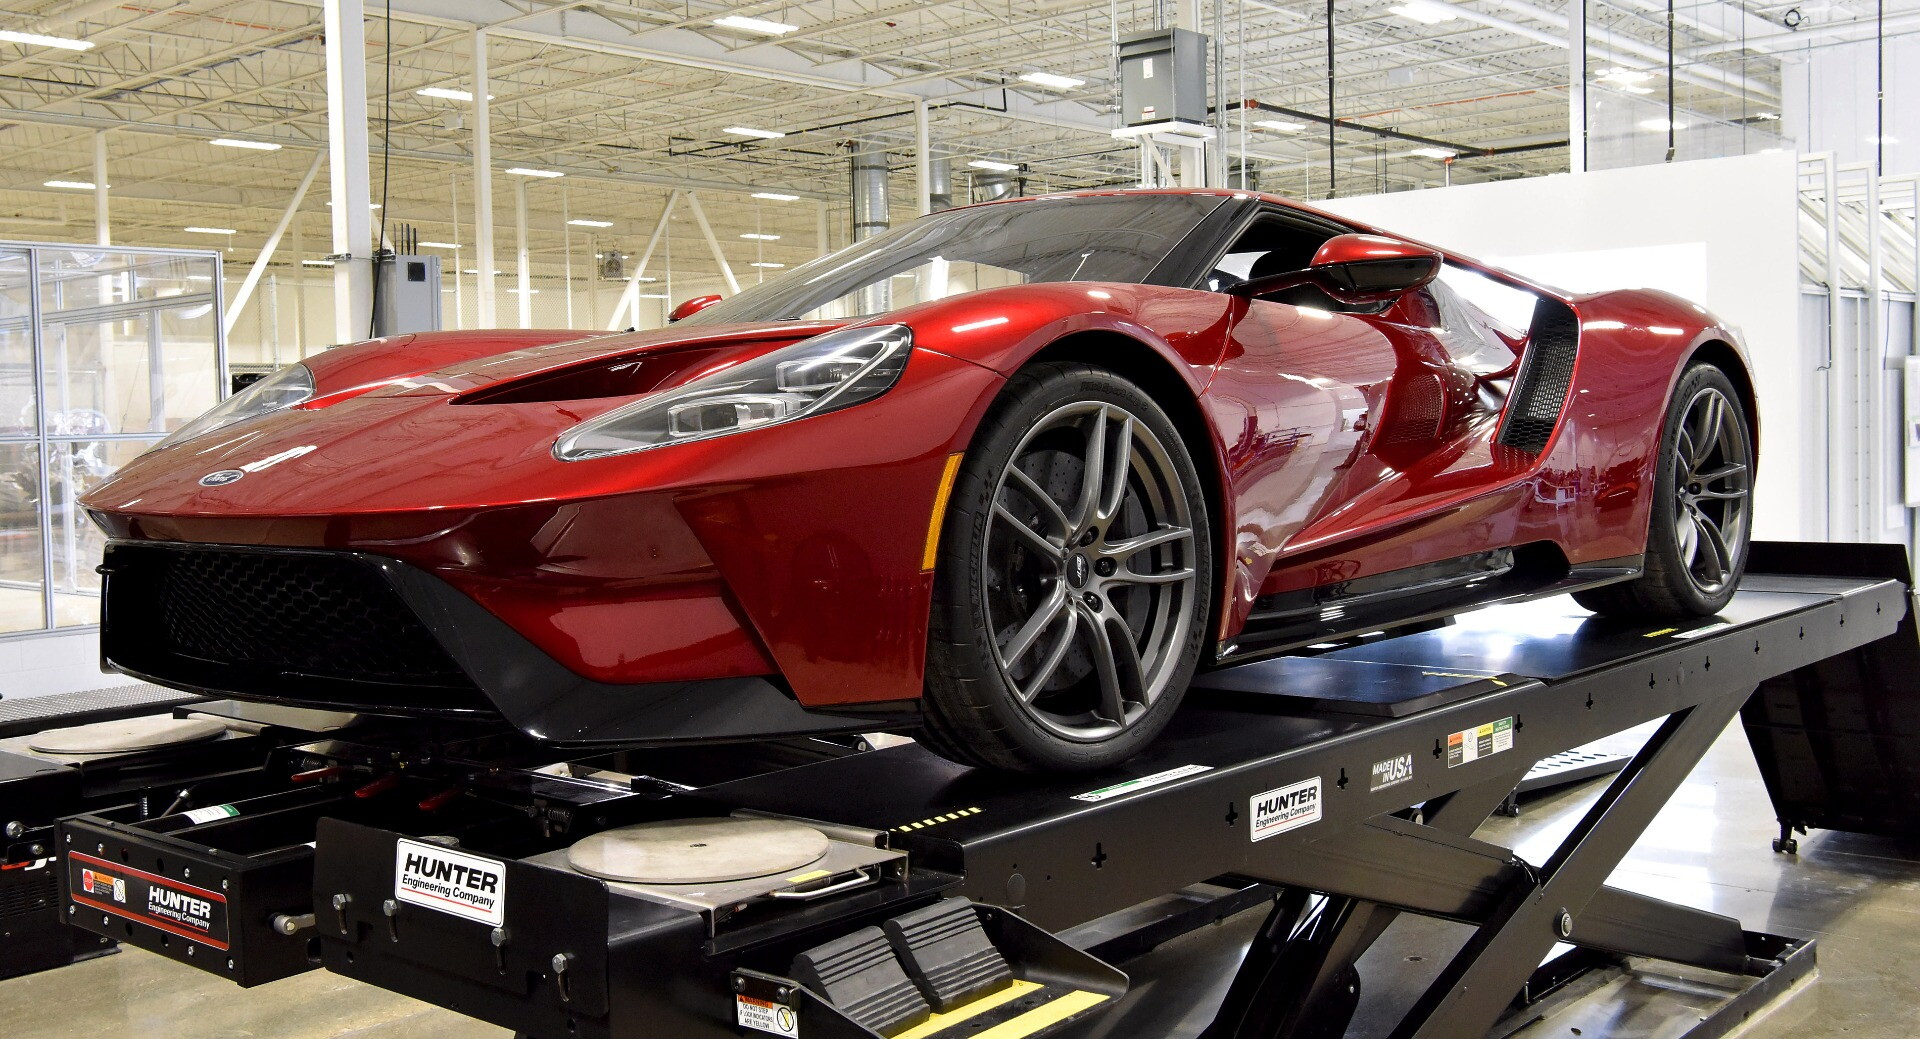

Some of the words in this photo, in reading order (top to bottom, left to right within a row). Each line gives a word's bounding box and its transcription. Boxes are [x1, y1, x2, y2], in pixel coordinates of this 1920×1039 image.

[970, 511, 986, 606] MICHELIN
[1372, 760, 1391, 776] MADE
[1382, 771, 1390, 783] IN
[1389, 754, 1413, 781] USA
[1255, 811, 1289, 828] Engineering
[1290, 803, 1316, 817] Company
[1257, 785, 1318, 818] HUNTER
[405, 853, 498, 894] HUNTER
[149, 885, 211, 919] HUNTER
[402, 873, 451, 898] Engineering
[452, 886, 495, 909] Company
[148, 901, 181, 922] Engineering
[182, 912, 210, 930] Company
[753, 1019, 770, 1029] YELLOW
[758, 1006, 769, 1014] STEP
